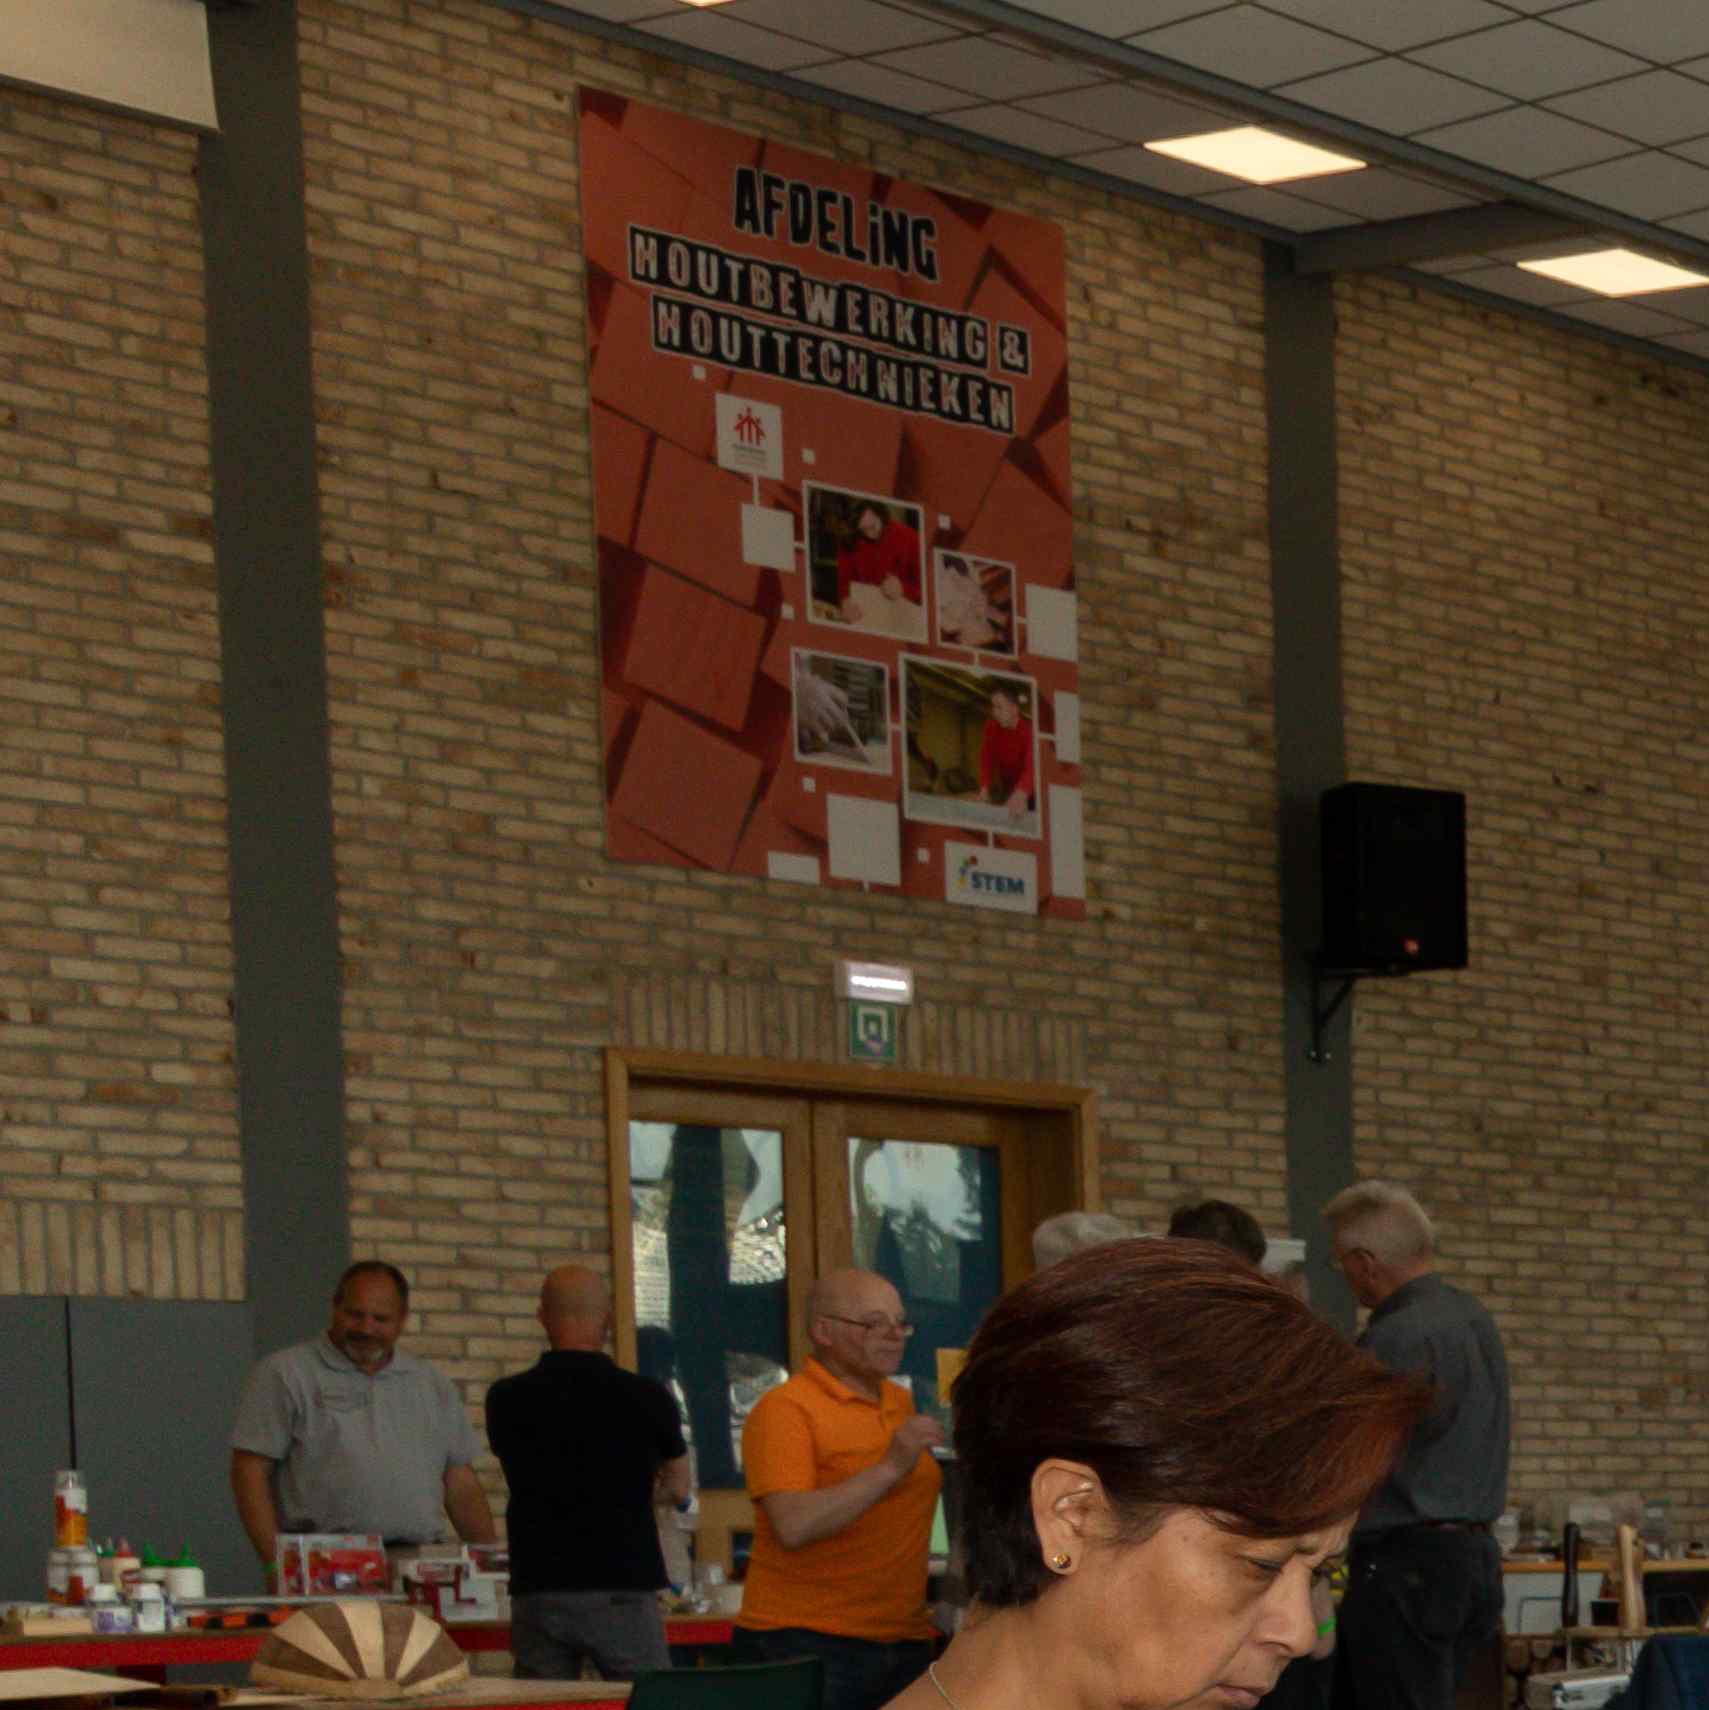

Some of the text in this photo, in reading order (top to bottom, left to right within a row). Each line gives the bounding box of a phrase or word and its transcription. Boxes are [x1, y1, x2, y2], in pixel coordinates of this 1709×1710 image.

[633, 233, 1026, 368] HOUTBEWERKING &
[657, 299, 1011, 429] HOUTTECHNIEKEN
[972, 872, 1024, 895] STEM
